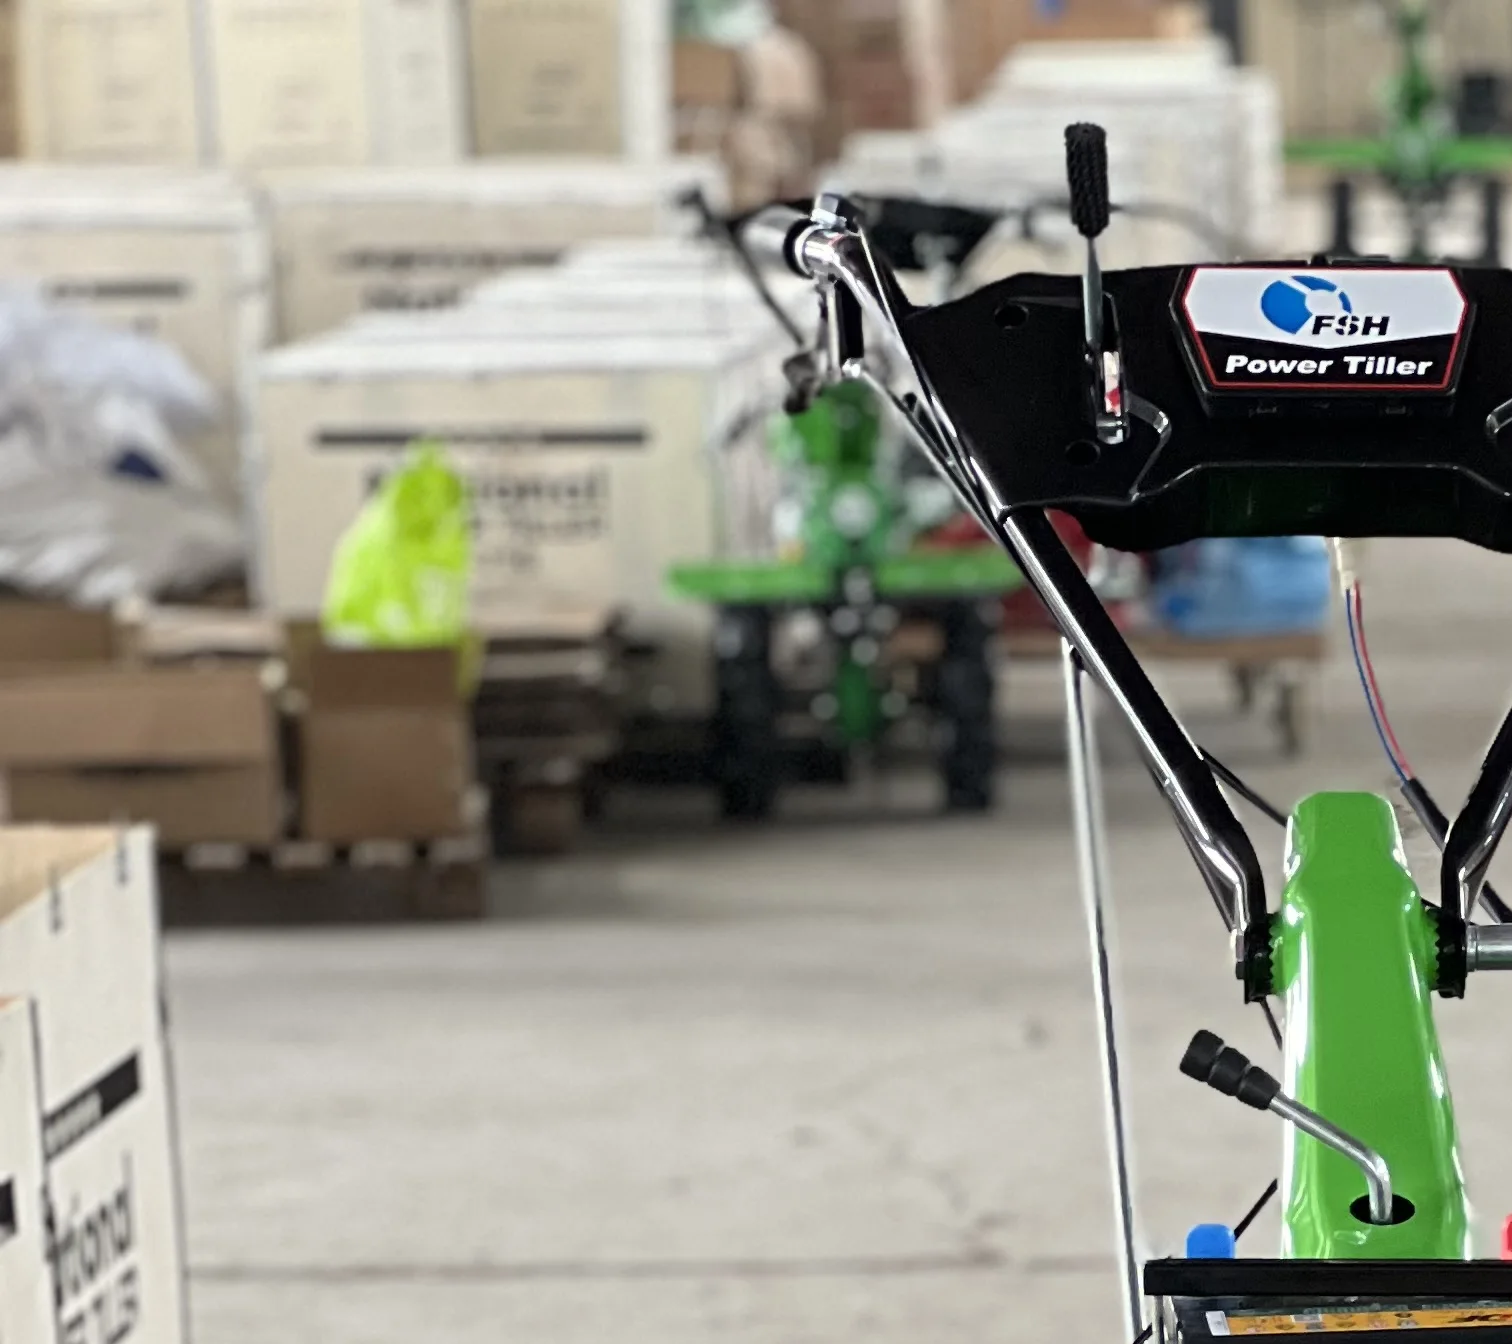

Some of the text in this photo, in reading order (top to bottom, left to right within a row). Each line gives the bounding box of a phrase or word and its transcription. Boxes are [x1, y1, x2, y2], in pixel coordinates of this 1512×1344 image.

[1311, 315, 1391, 336] FSH
[1225, 354, 1433, 376] Power Tiller
